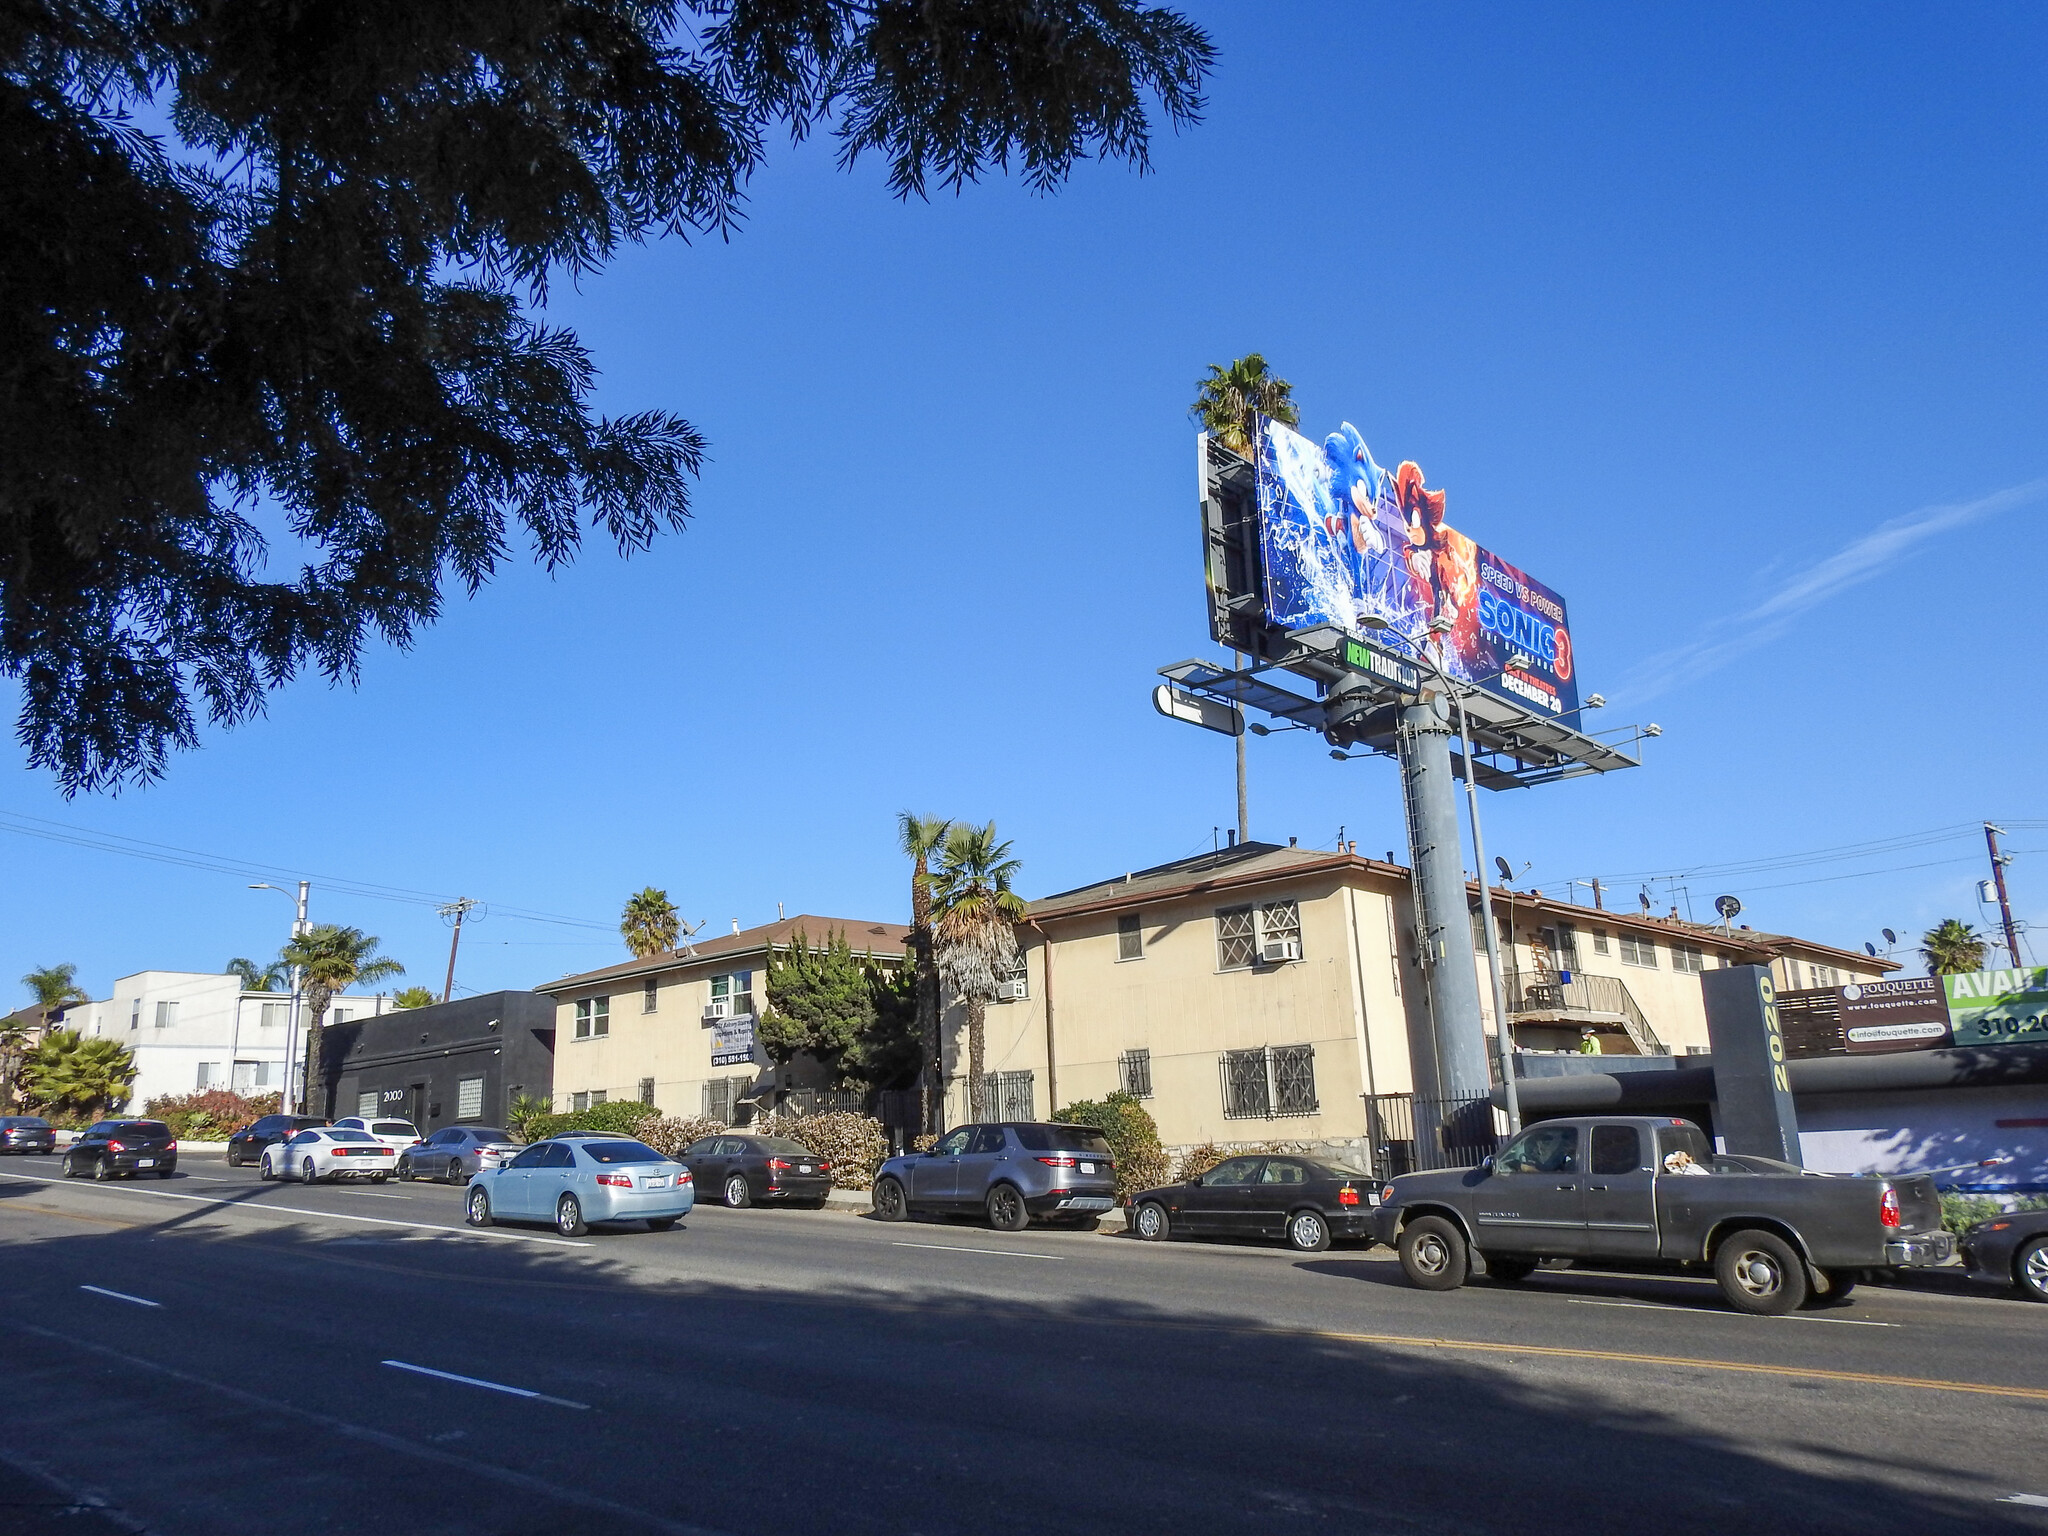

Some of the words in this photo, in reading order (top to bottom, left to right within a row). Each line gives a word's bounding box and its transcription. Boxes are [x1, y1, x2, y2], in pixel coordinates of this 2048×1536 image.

[1481, 563, 1513, 594] SPEED
[1515, 581, 1530, 603] VS
[1530, 590, 1563, 624] POWER
[1478, 590, 1555, 661] SONIC
[1553, 628, 1571, 680] 3
[1480, 627, 1498, 645] THE
[1501, 672, 1549, 708] DECEMBER
[1550, 695, 1562, 714] 20
[1862, 979, 1935, 994] FOUQUETTE
[1847, 998, 1938, 1011] www.fouquette.com
[1760, 976, 1790, 1093] 2020
[1856, 1026, 1943, 1039] info@fouquette.com
[383, 1089, 403, 1103] 2000
